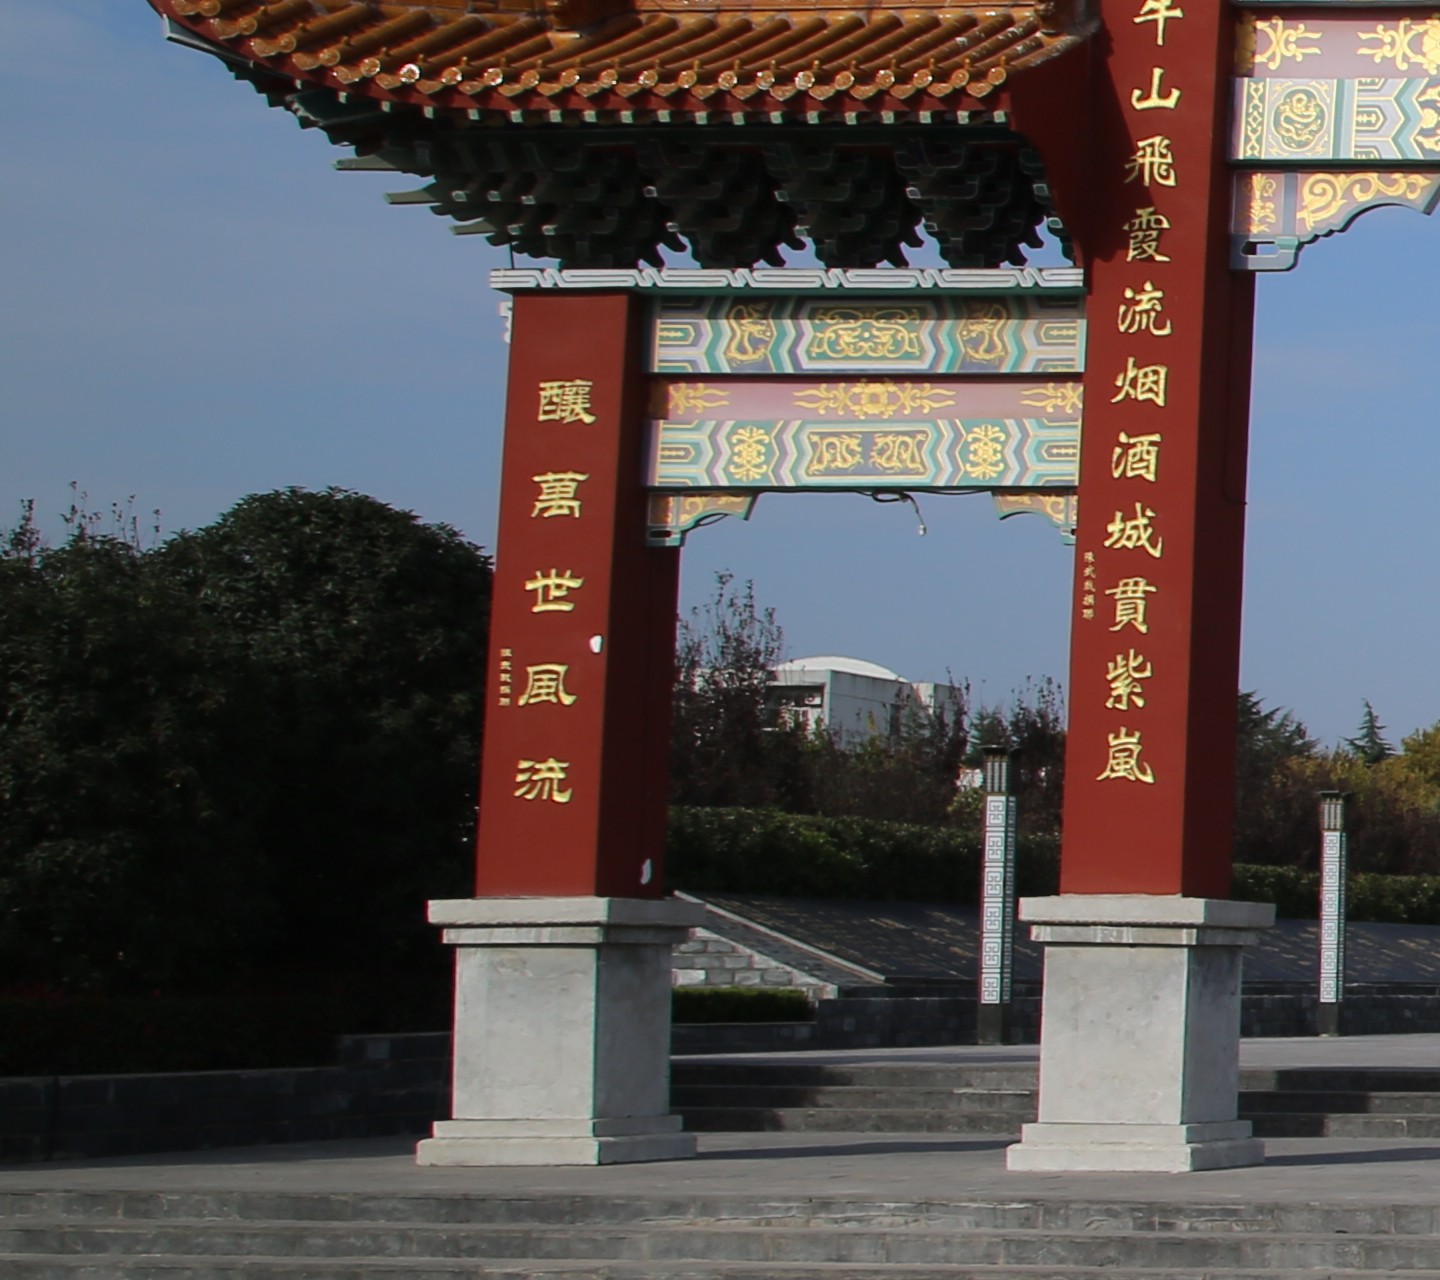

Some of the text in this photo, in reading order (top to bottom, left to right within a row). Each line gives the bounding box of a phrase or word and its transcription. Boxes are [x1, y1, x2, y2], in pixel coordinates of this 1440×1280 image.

[514, 380, 596, 804] 釀萬世風流
